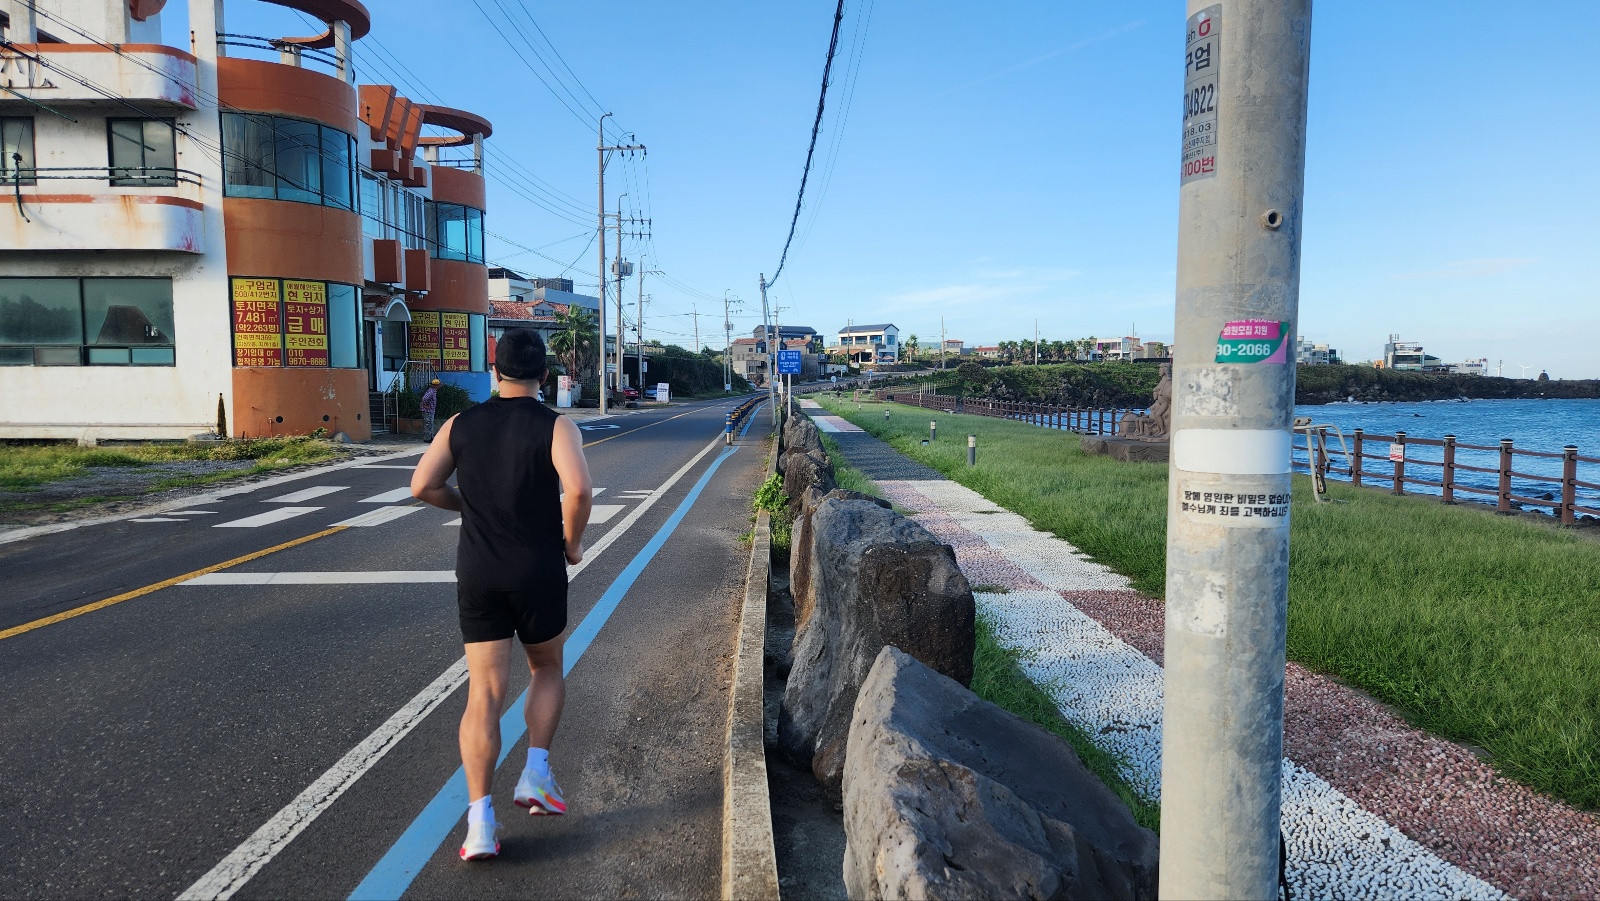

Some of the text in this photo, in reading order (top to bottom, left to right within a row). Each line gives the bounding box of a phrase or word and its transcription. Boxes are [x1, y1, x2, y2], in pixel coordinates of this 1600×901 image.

[1184, 155, 1215, 178] 100번
[245, 280, 276, 291] 구엄리
[287, 290, 323, 303] 현 위치
[235, 301, 278, 312] 토지면적
[287, 304, 324, 315] 토지+상가
[1223, 325, 1268, 336] 회원모집 지원
[288, 336, 324, 347] 주인전화
[288, 348, 304, 358] 010
[1184, 490, 1201, 501] 땅에
[1203, 492, 1234, 504] 영원한
[1237, 493, 1267, 505] 비밀은
[1219, 505, 1240, 517] 죄를
